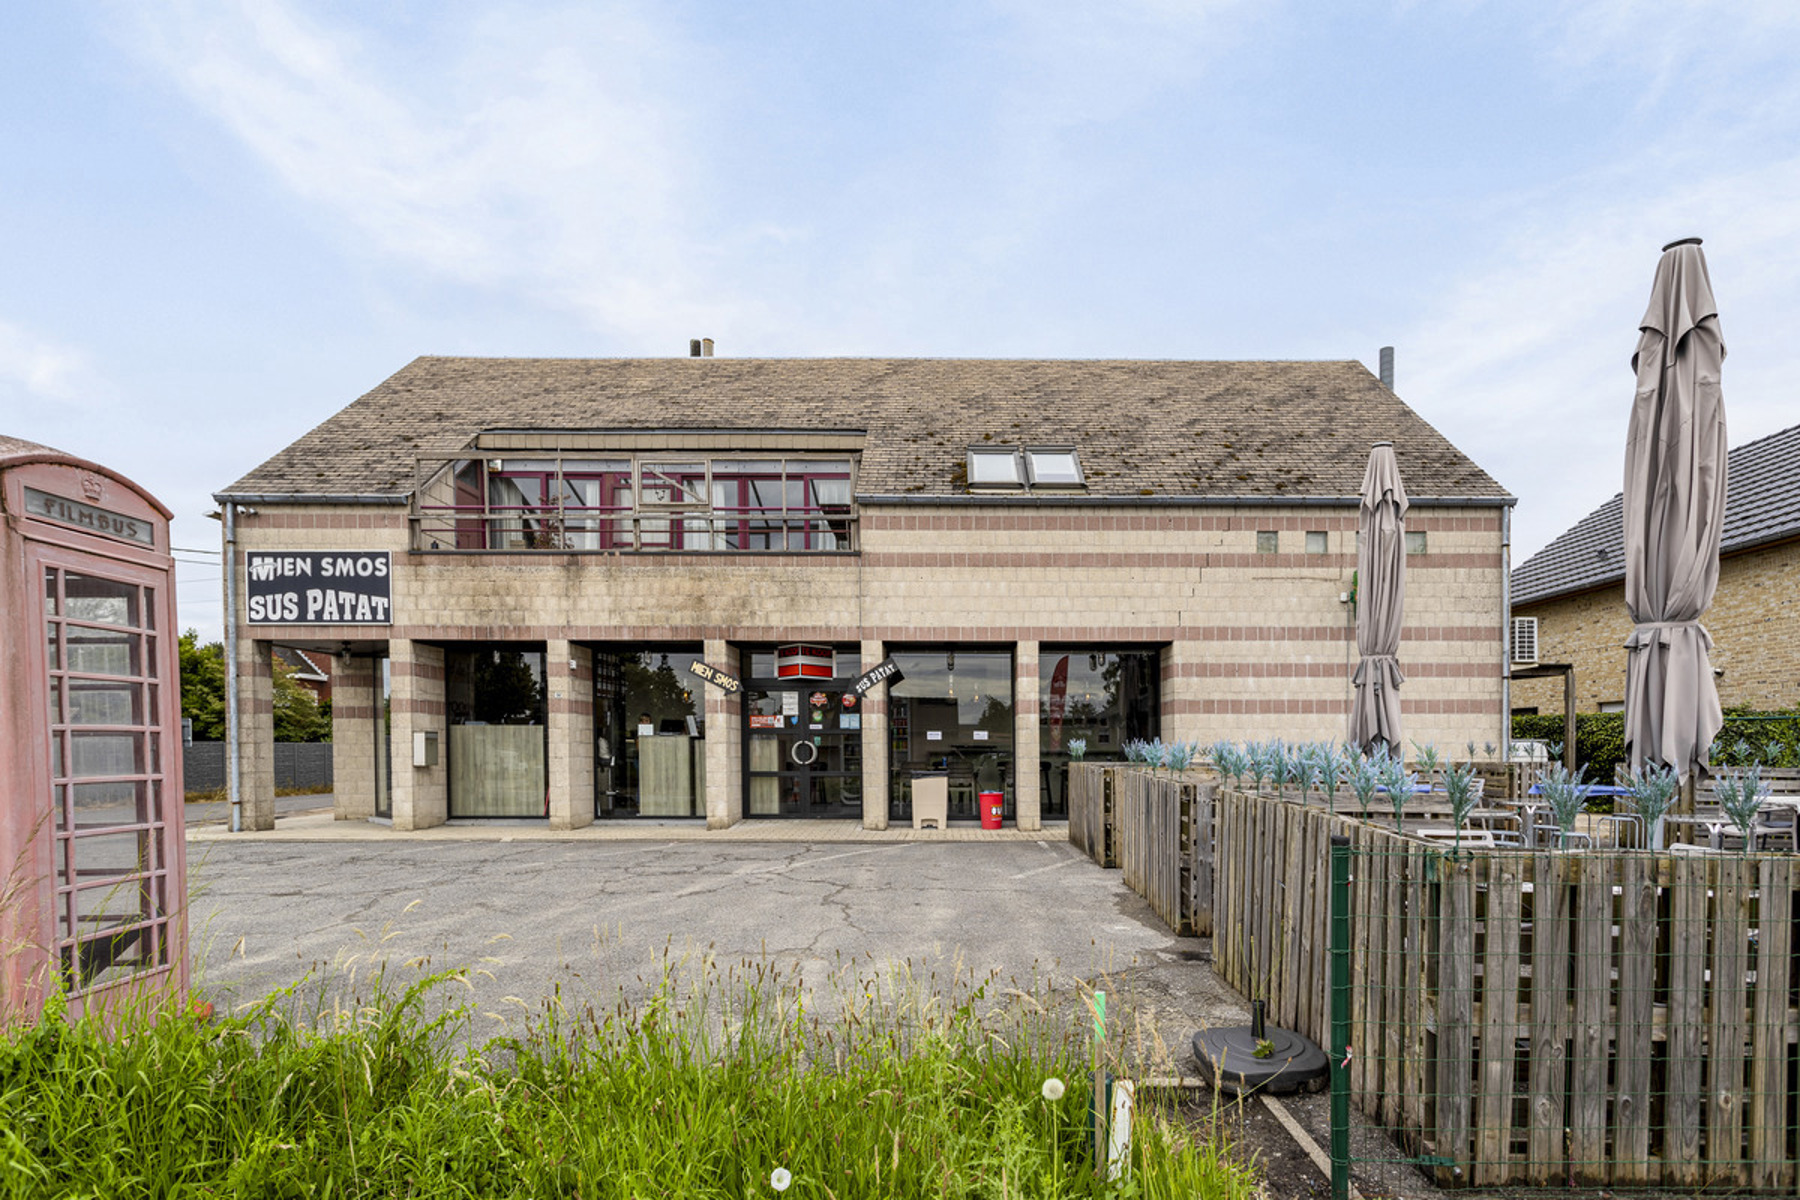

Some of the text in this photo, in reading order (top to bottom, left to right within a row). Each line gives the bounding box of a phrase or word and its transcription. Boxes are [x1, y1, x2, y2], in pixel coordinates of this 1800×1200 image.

[43, 497, 137, 538] FILMBUS
[249, 556, 388, 581] MIEN SMOS
[250, 588, 389, 621] SUS PATAT
[713, 672, 739, 692] SMOS
[855, 664, 895, 693] SUS PATAT
